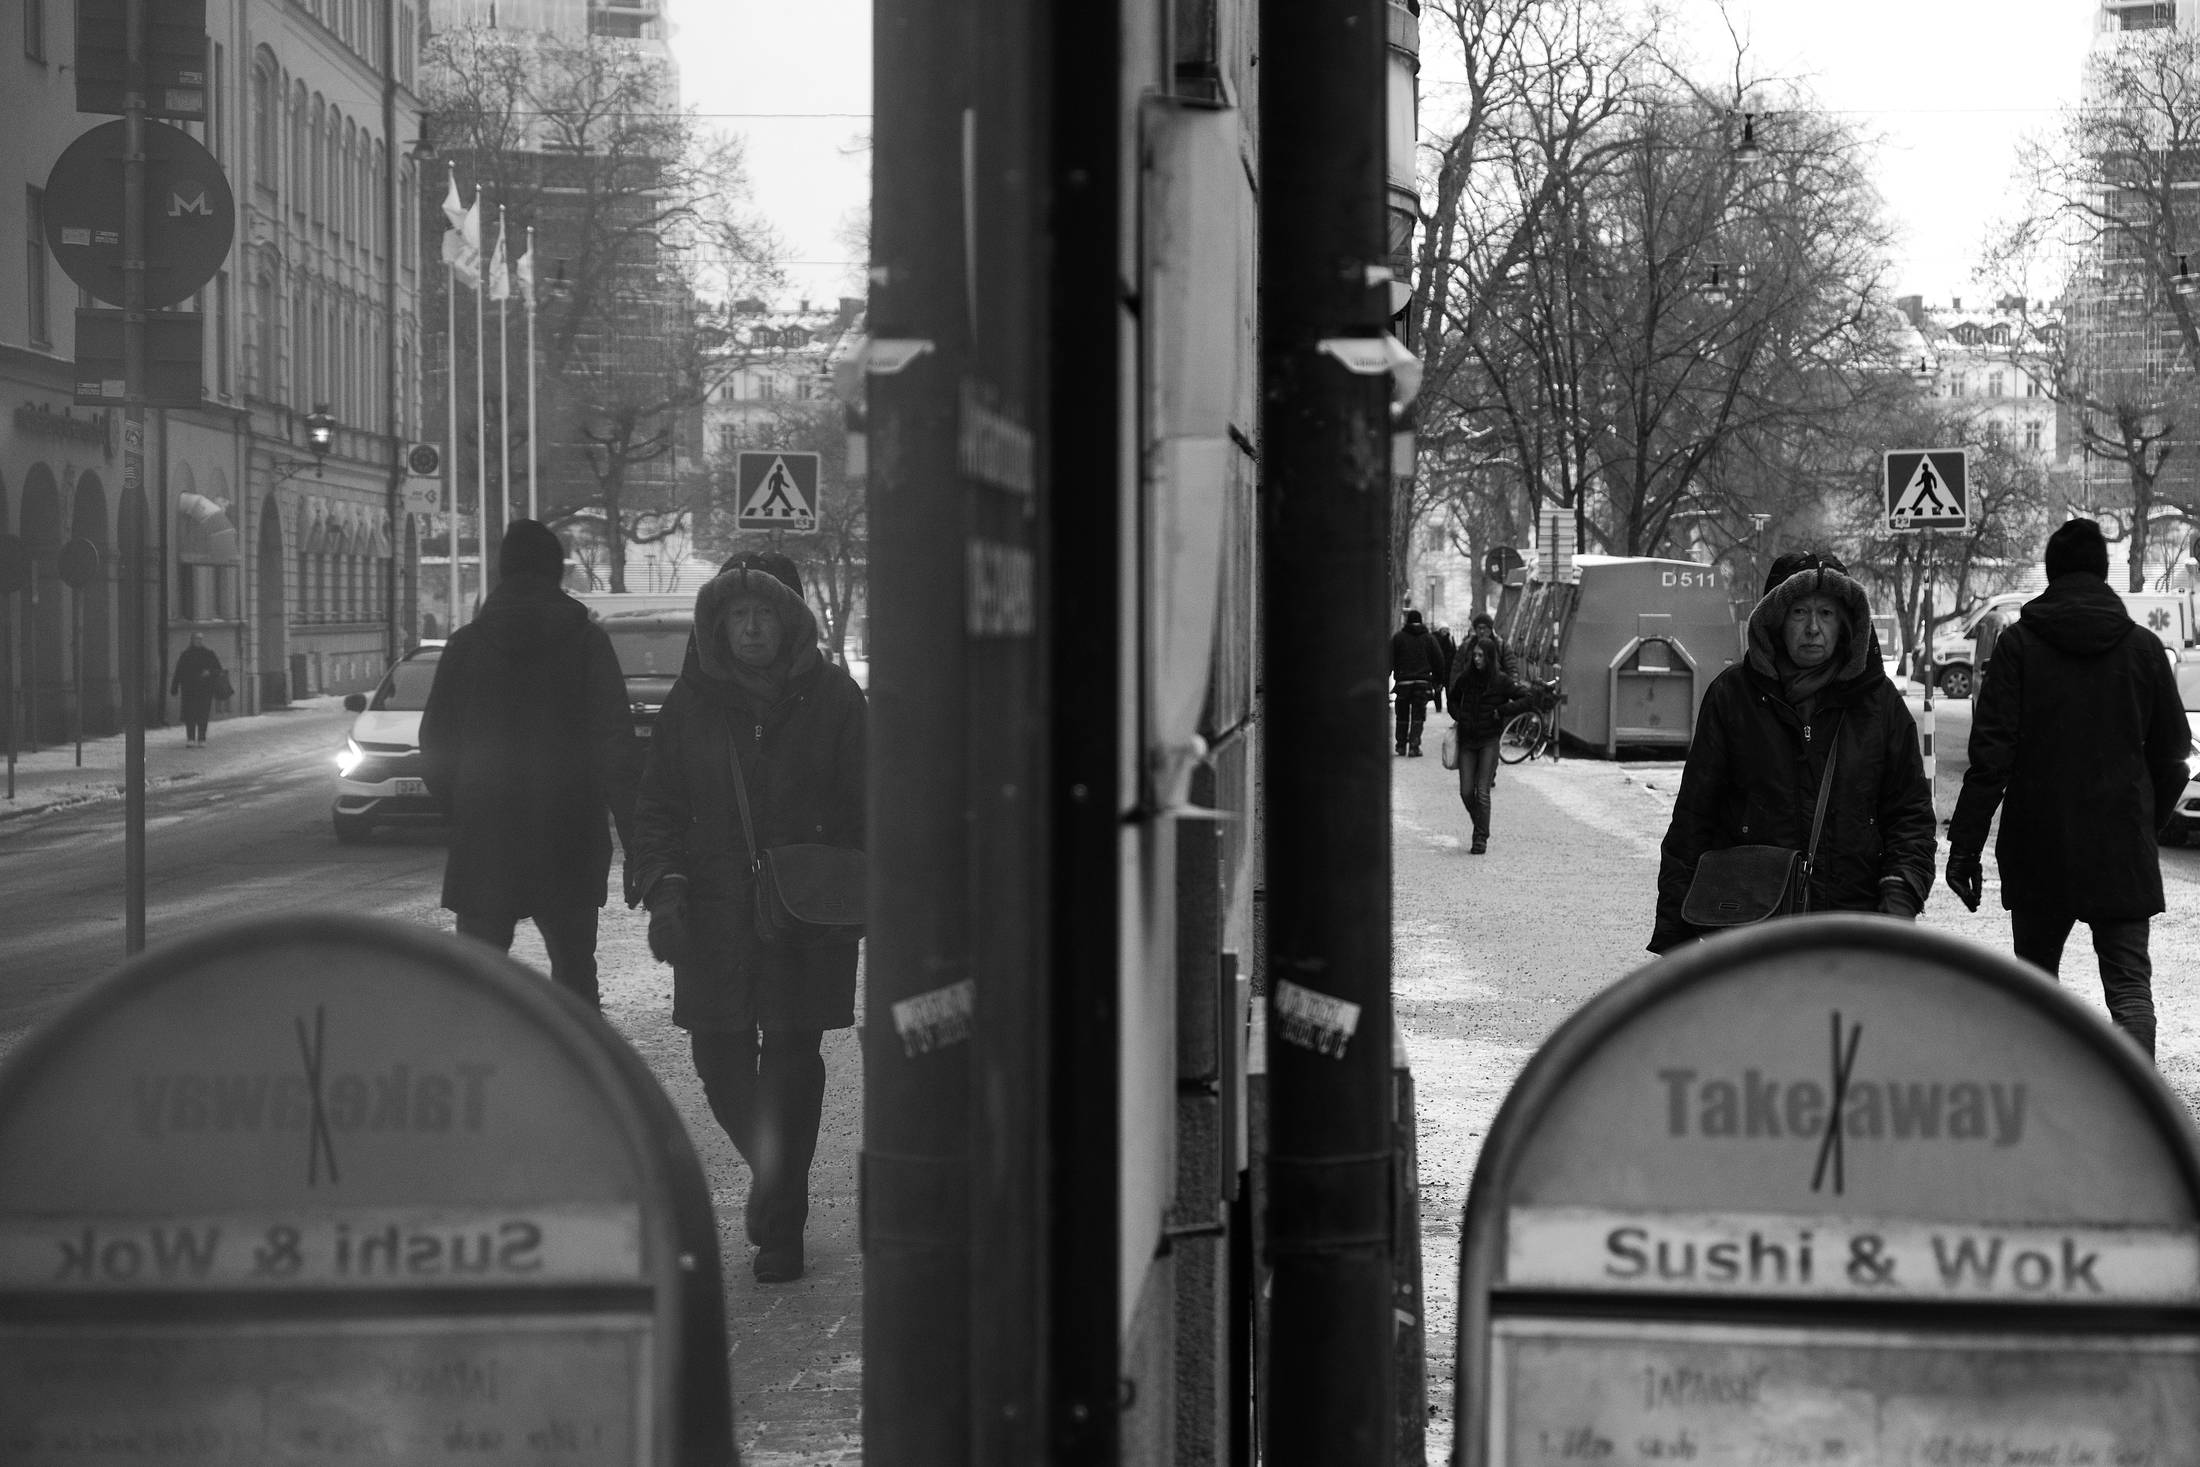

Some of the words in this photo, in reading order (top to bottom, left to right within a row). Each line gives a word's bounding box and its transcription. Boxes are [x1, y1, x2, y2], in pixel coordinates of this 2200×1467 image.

[1661, 571, 1715, 588] D511
[1605, 1227, 1814, 1284] Sushi
[1846, 1233, 1896, 1287] &
[1931, 1236, 2102, 1292] Wok
